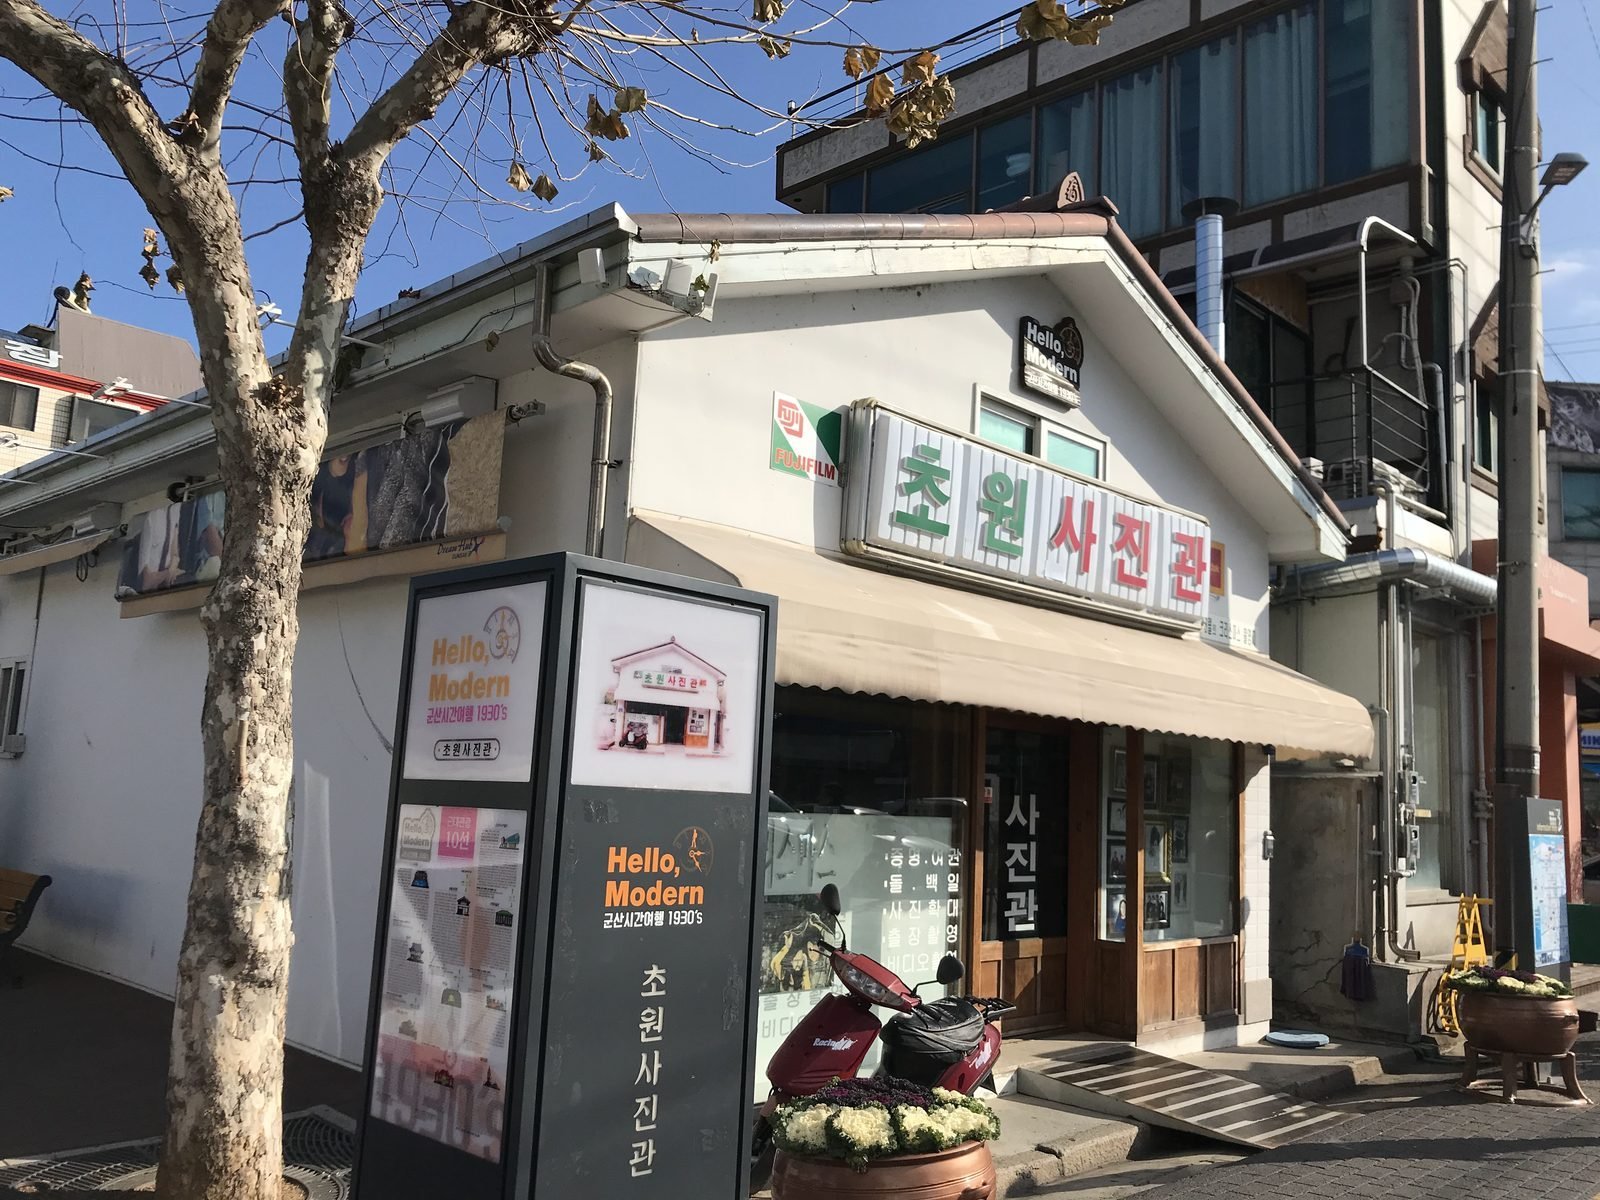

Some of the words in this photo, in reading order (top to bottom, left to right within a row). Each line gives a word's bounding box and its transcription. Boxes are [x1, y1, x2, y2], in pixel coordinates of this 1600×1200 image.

[1026, 322, 1065, 358] Hello,
[1025, 343, 1078, 383] Modern
[775, 447, 836, 481] FUJIFILM
[892, 443, 1208, 603] 초원사진관
[431, 634, 490, 667] Hello,
[428, 671, 510, 702] Modern
[476, 703, 508, 721] 1930's
[442, 742, 492, 757] 초원사진관
[607, 846, 680, 878] Hello,
[1004, 793, 1040, 932] 사진관
[604, 879, 704, 907] Modern
[603, 910, 665, 929] 군산시간여행
[668, 909, 703, 925] 1930's
[628, 963, 668, 1178] 초원사진관
